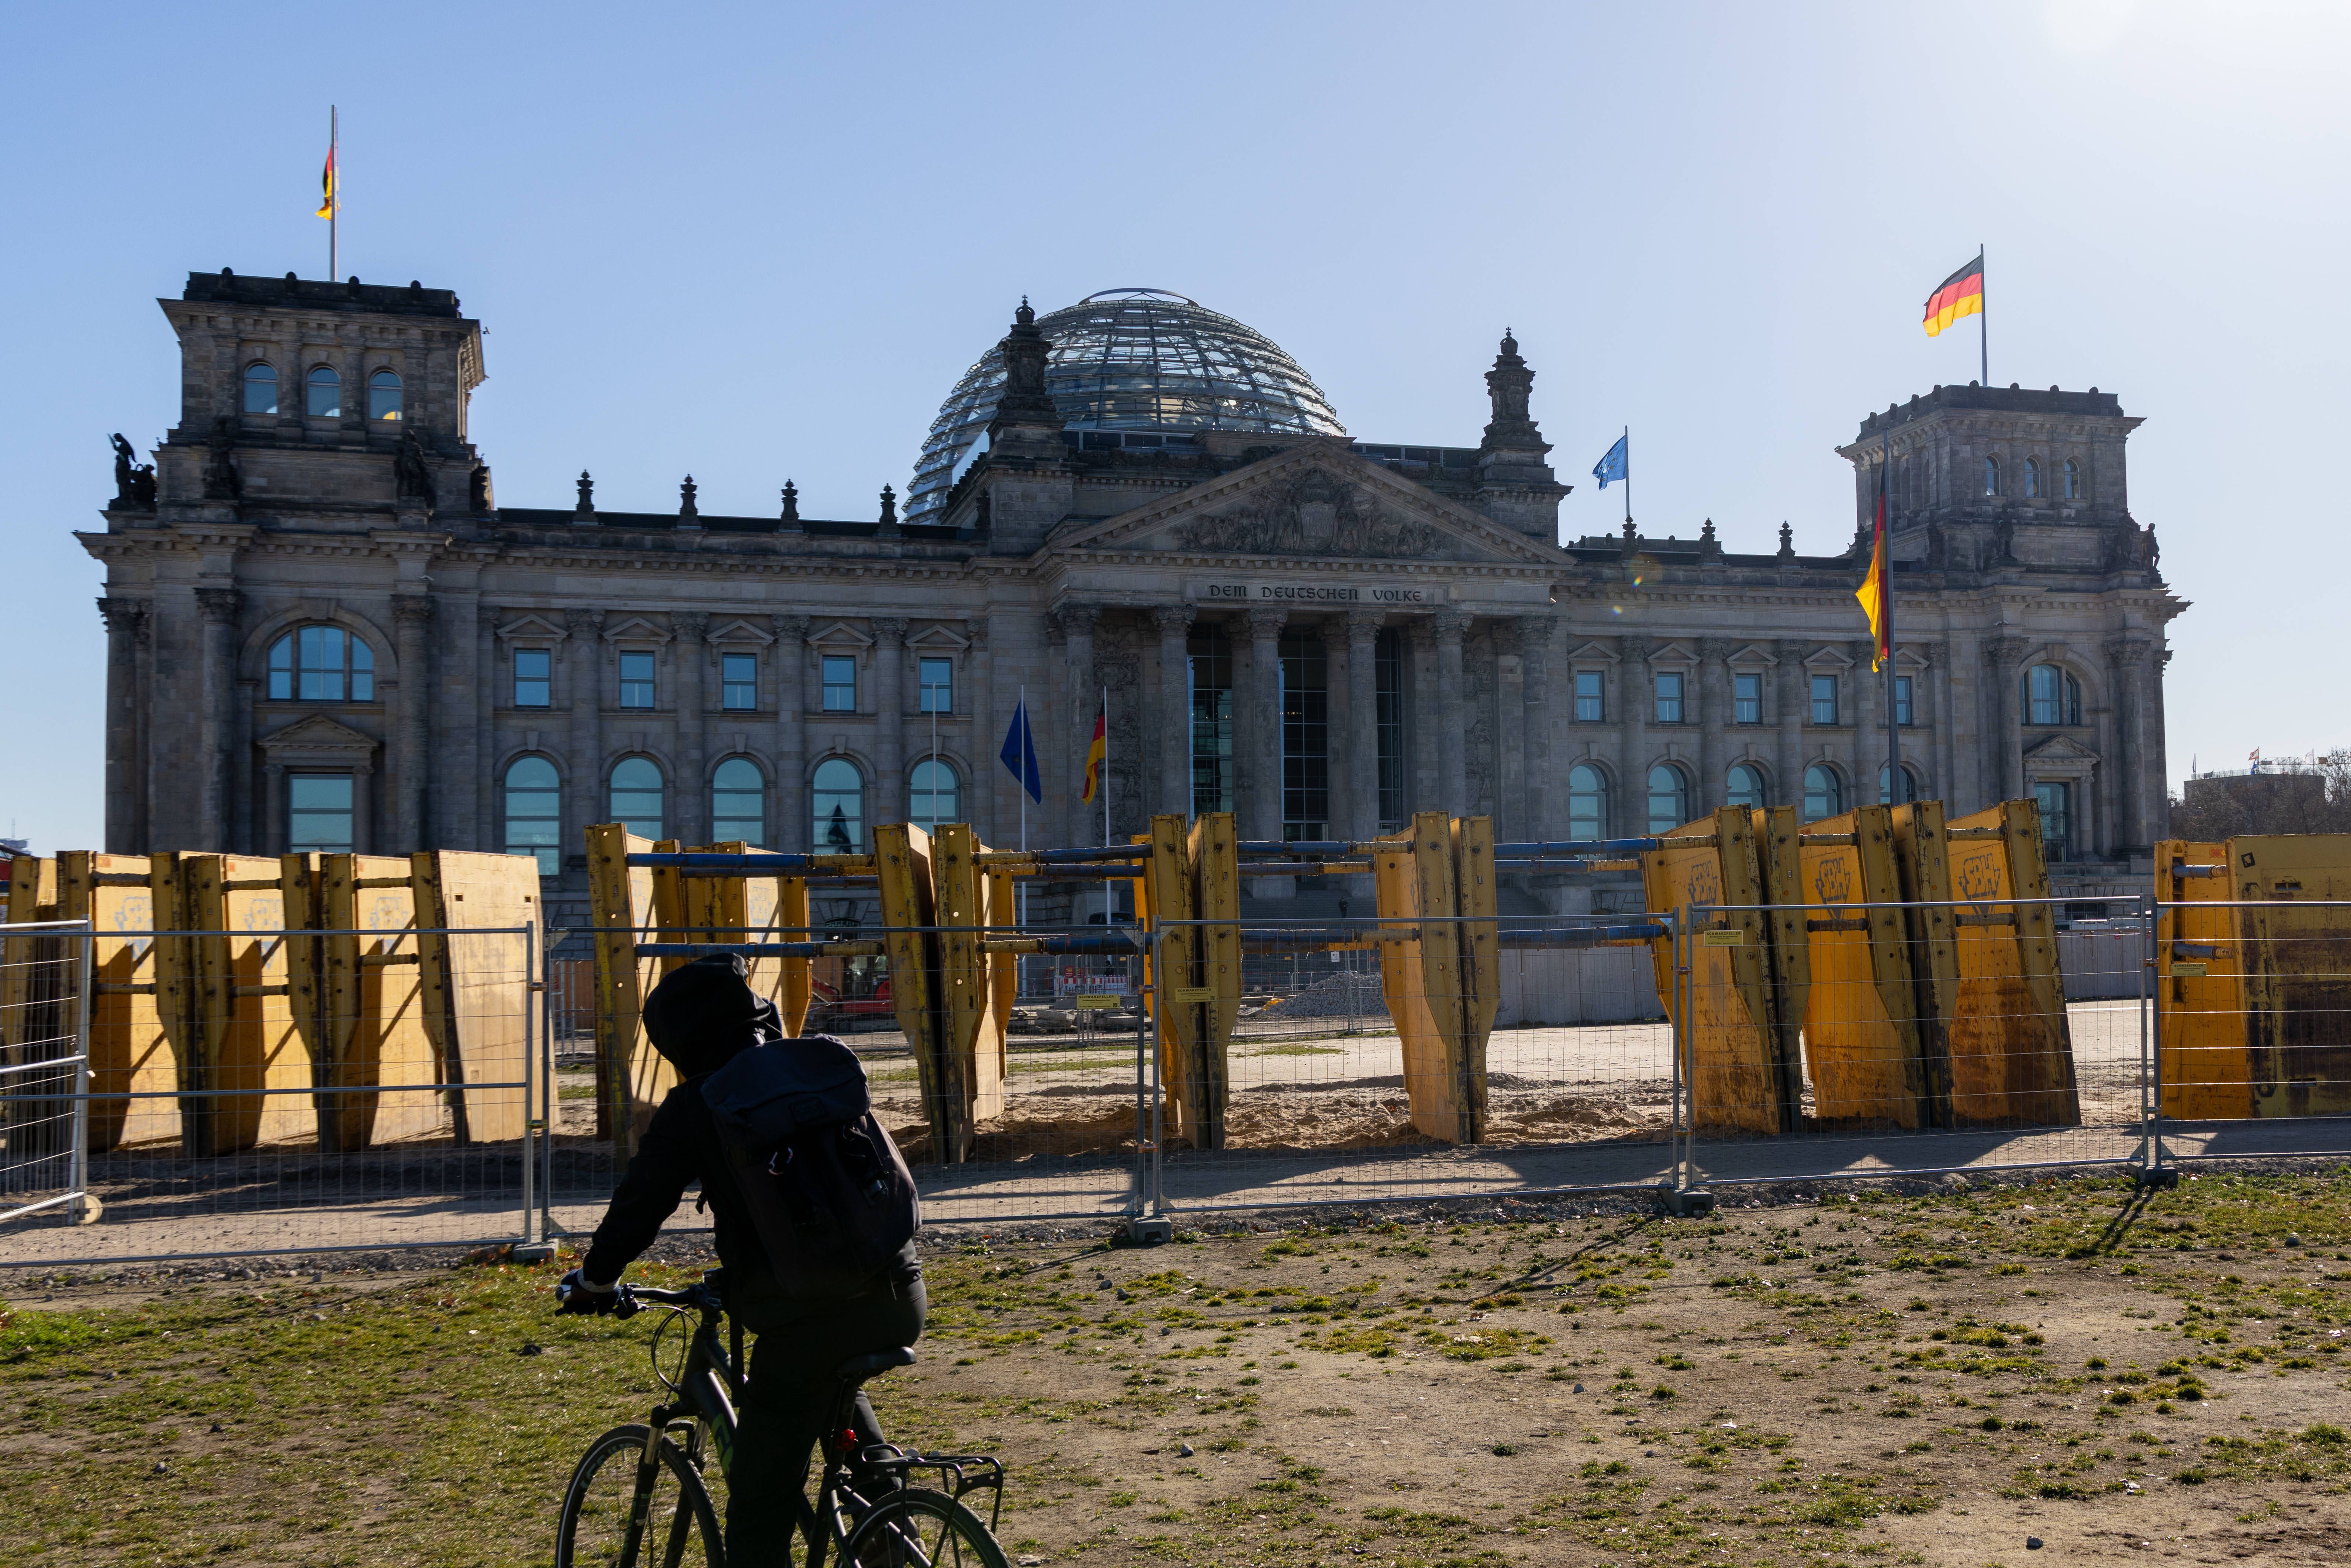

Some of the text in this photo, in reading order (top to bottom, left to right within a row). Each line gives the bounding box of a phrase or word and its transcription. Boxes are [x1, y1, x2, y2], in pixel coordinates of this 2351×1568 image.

[1209, 585, 1421, 602] DEM DEUTSCHEN VOLKE
